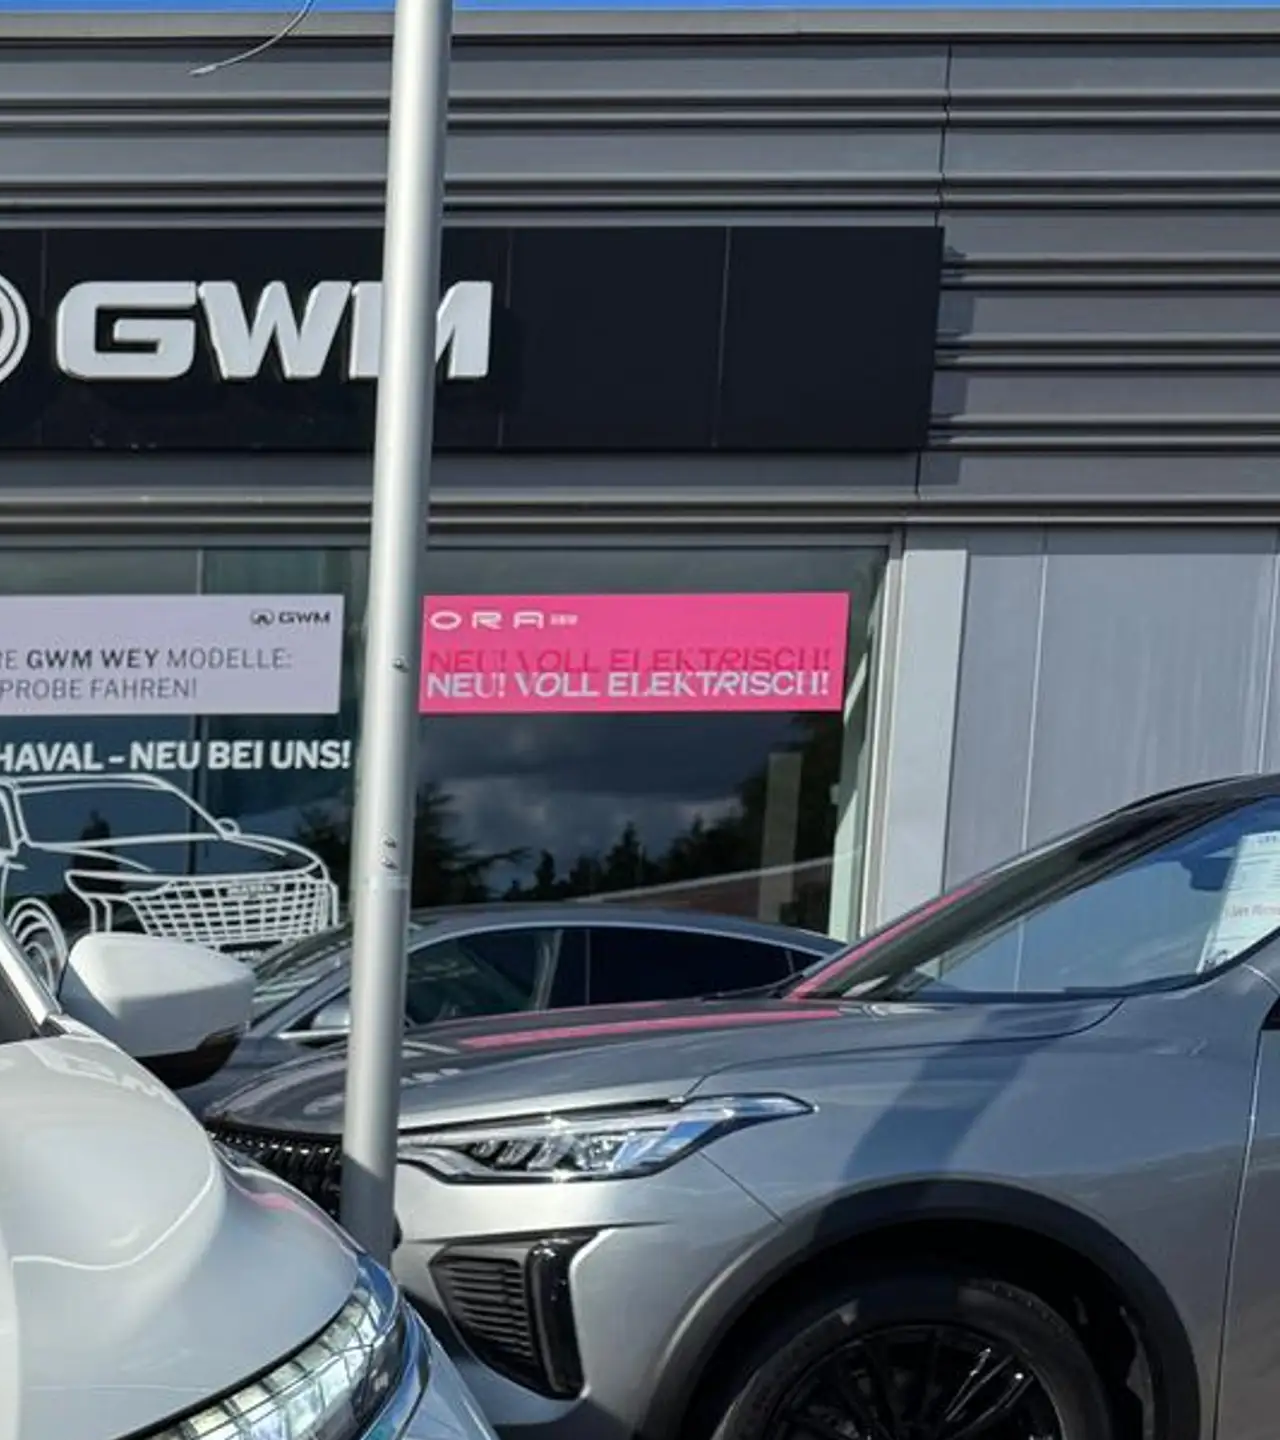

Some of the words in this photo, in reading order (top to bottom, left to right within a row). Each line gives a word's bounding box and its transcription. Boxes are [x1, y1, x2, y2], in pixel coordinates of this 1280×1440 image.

[56, 280, 493, 381] GWM
[278, 611, 331, 624] GWM
[428, 610, 545, 630] ORA
[26, 648, 93, 670] GWM
[101, 648, 161, 669] WEY
[167, 647, 293, 669] MODELLE:
[90, 677, 197, 699] FAHREN!
[426, 671, 505, 699] NEU!
[517, 671, 600, 698] VOLL
[130, 742, 201, 771] NEU
[208, 741, 263, 770] BEI
[270, 740, 351, 770] UNS!
